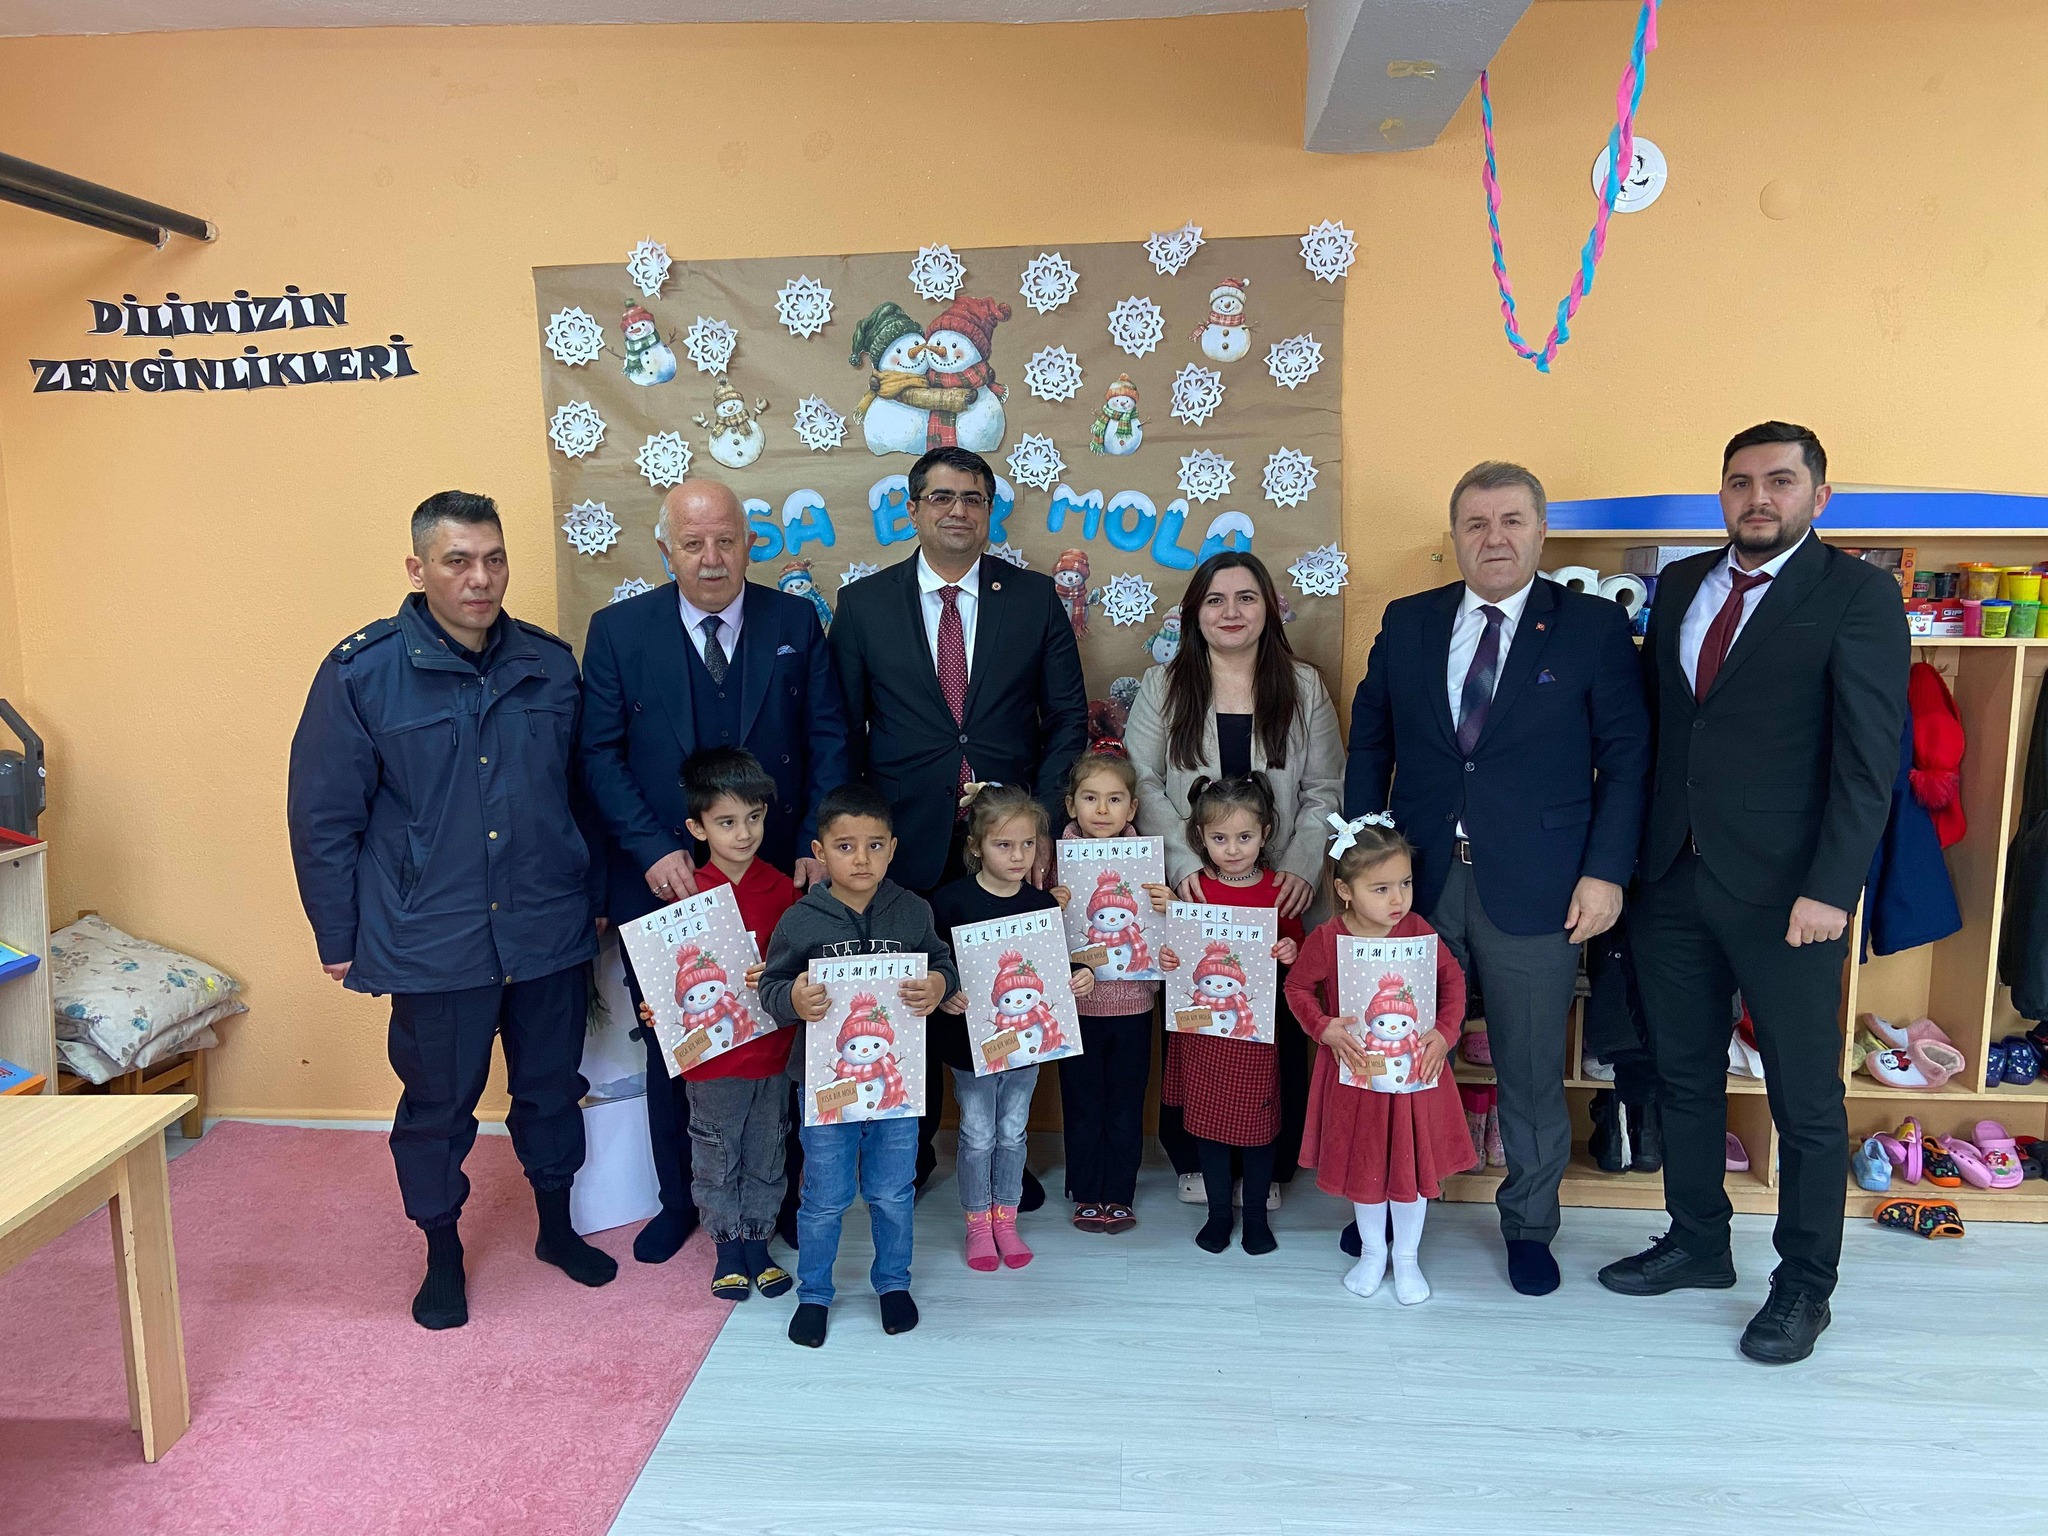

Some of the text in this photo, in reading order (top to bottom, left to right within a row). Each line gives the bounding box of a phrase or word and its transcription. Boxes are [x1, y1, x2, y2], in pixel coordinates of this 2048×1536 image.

[86, 284, 347, 339] DİLİMİZİN
[28, 334, 420, 393] ZENGİNLİKLERİ
[1066, 846, 1148, 858] ZEYNEP
[645, 896, 713, 931] EYMEN
[1175, 908, 1229, 921] ASEL
[666, 921, 703, 943] EFE
[964, 918, 1047, 943] ELİFSU
[1205, 927, 1259, 940] ASYA
[1356, 946, 1424, 958] AMİNE
[822, 963, 912, 979] İSMAİL
[821, 1094, 833, 1103] KISA
[841, 1087, 856, 1098] MOLA
